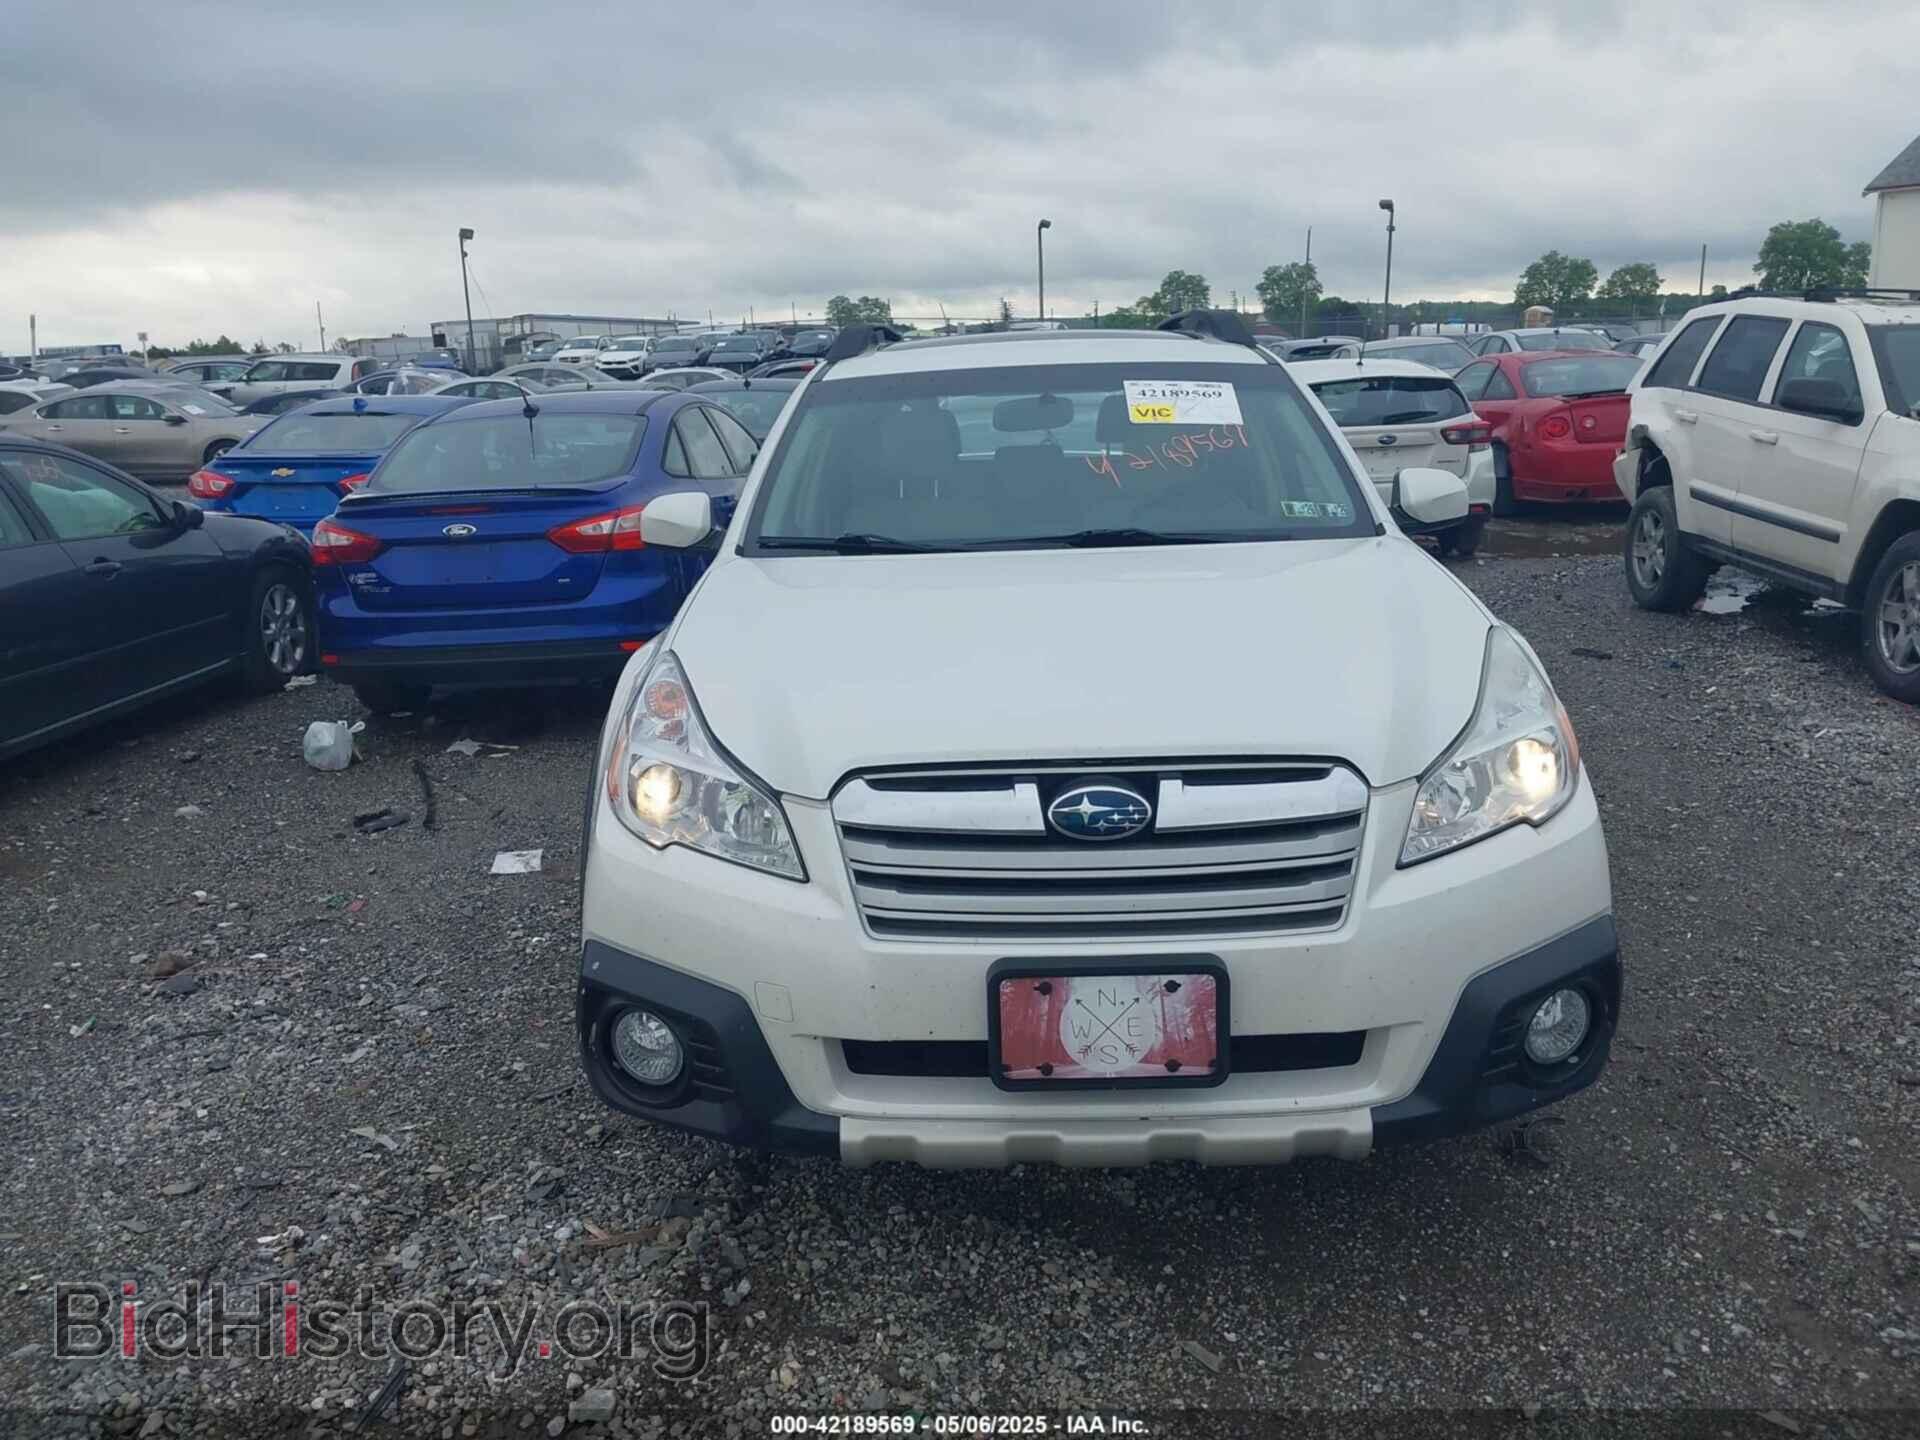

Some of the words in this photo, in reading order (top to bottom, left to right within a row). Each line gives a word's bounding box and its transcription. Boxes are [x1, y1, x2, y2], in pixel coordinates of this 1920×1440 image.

[1138, 389, 1223, 399] 42189569
[1135, 407, 1173, 418] VIC
[1071, 1018, 1093, 1039] W
[1127, 1016, 1144, 1037] E
[1100, 1044, 1119, 1065] S
